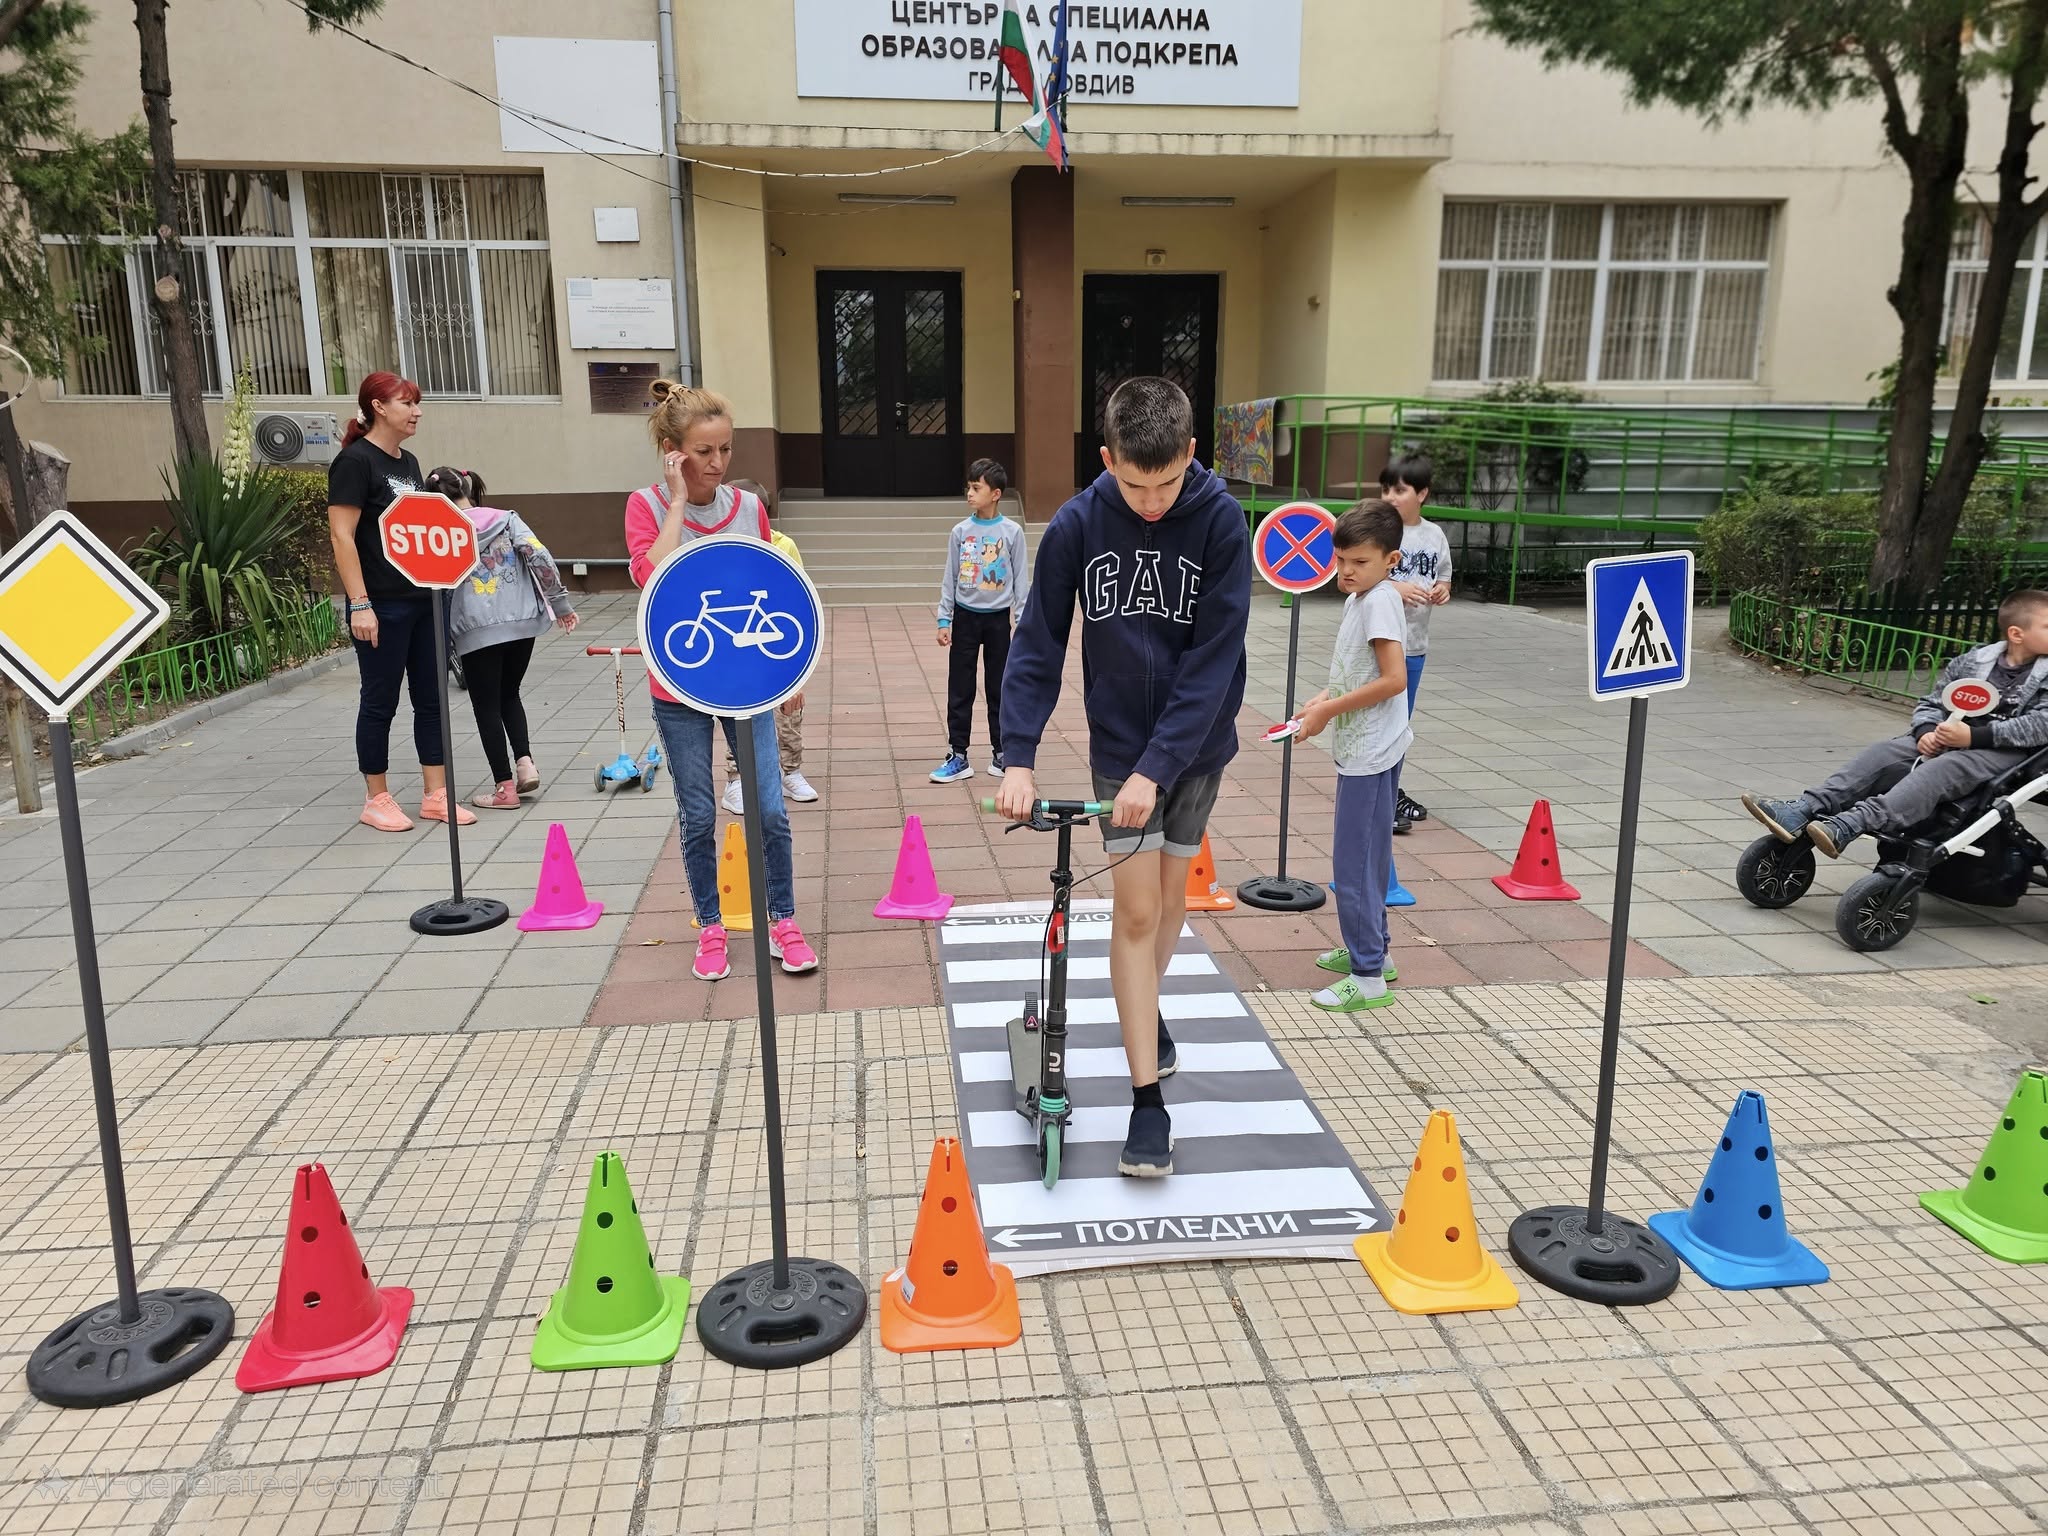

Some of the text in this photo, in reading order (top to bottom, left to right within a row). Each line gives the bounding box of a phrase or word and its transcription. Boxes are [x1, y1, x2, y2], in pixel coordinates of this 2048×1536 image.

[892, 0, 999, 27] ЦЕНТЪР
[1026, 4, 1041, 27] А
[1096, 41, 1238, 66] ПОДКРЕПА
[389, 523, 469, 558] STOP
[1954, 690, 1987, 705] STOP
[1075, 1213, 1300, 1243] ПОГЛЕДНИ
